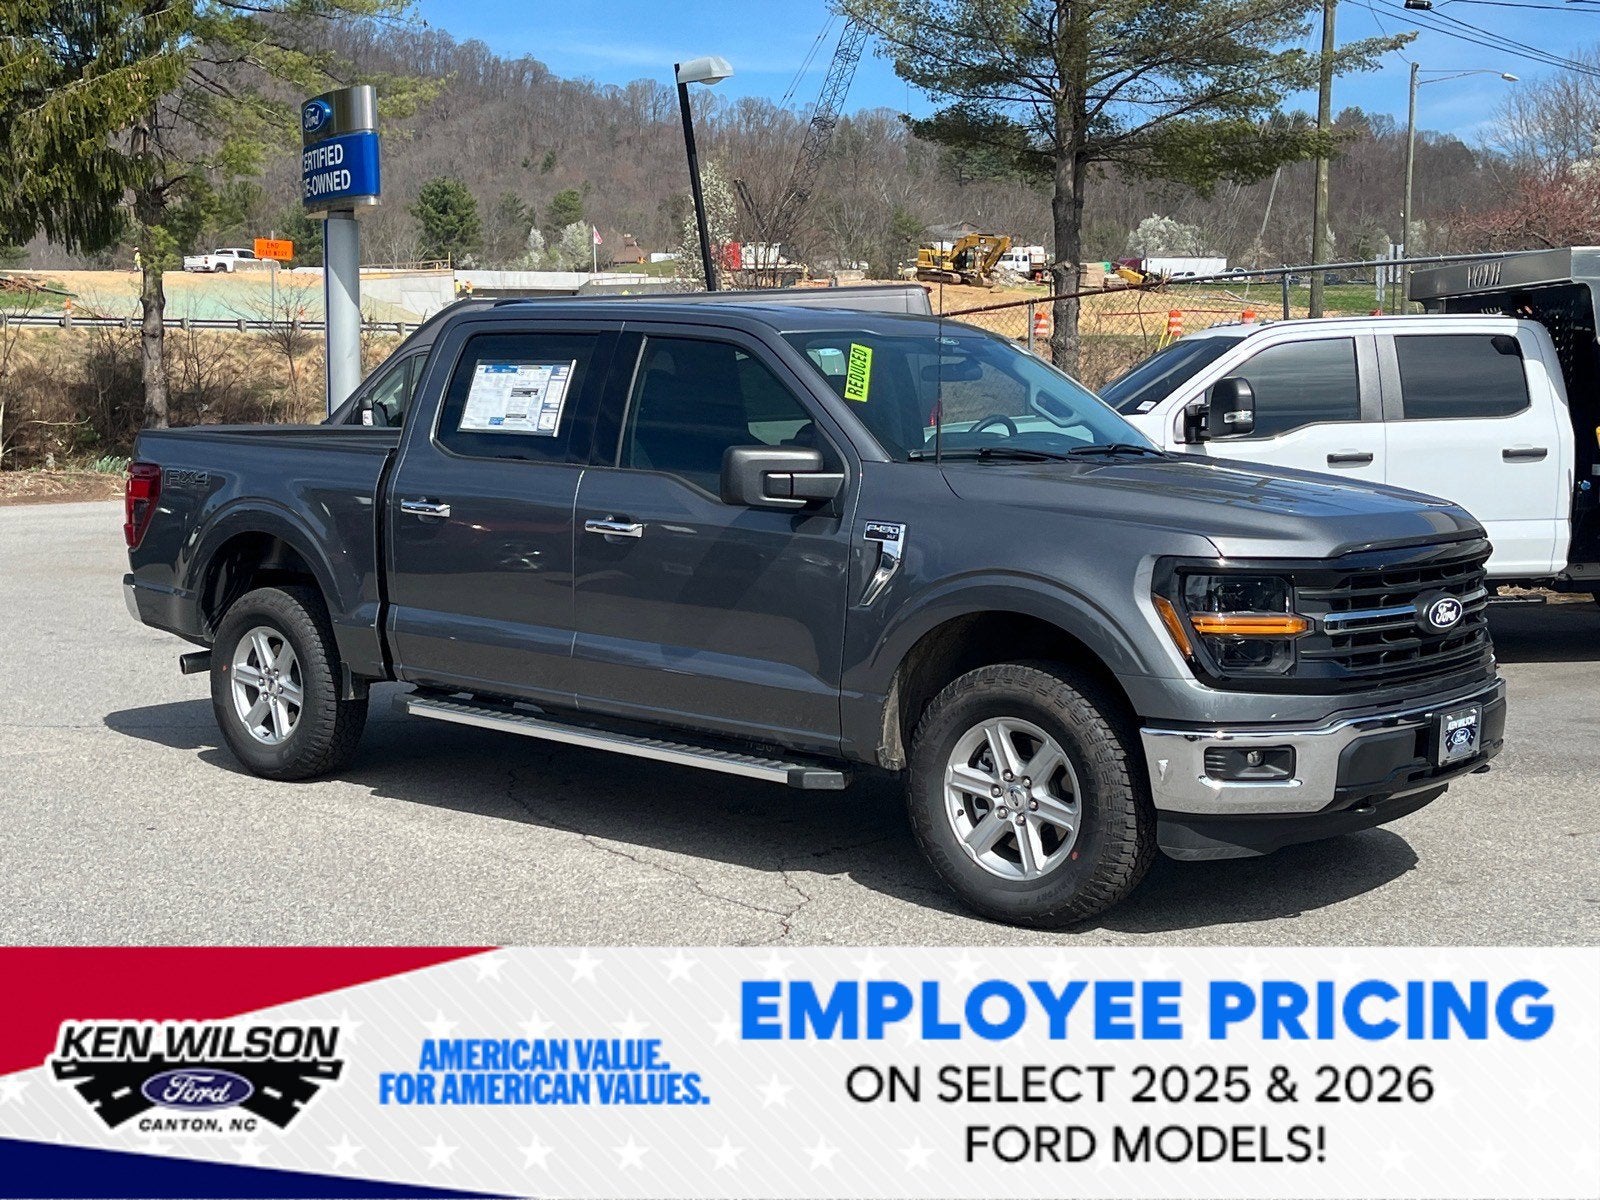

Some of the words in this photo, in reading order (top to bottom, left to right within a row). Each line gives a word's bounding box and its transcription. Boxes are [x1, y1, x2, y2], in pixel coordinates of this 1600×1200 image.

[304, 107, 320, 128] Ford
[303, 144, 344, 172] ERTIFIED
[847, 347, 867, 397] REDUCED
[165, 468, 208, 486] FX4
[1435, 602, 1457, 624] Ford
